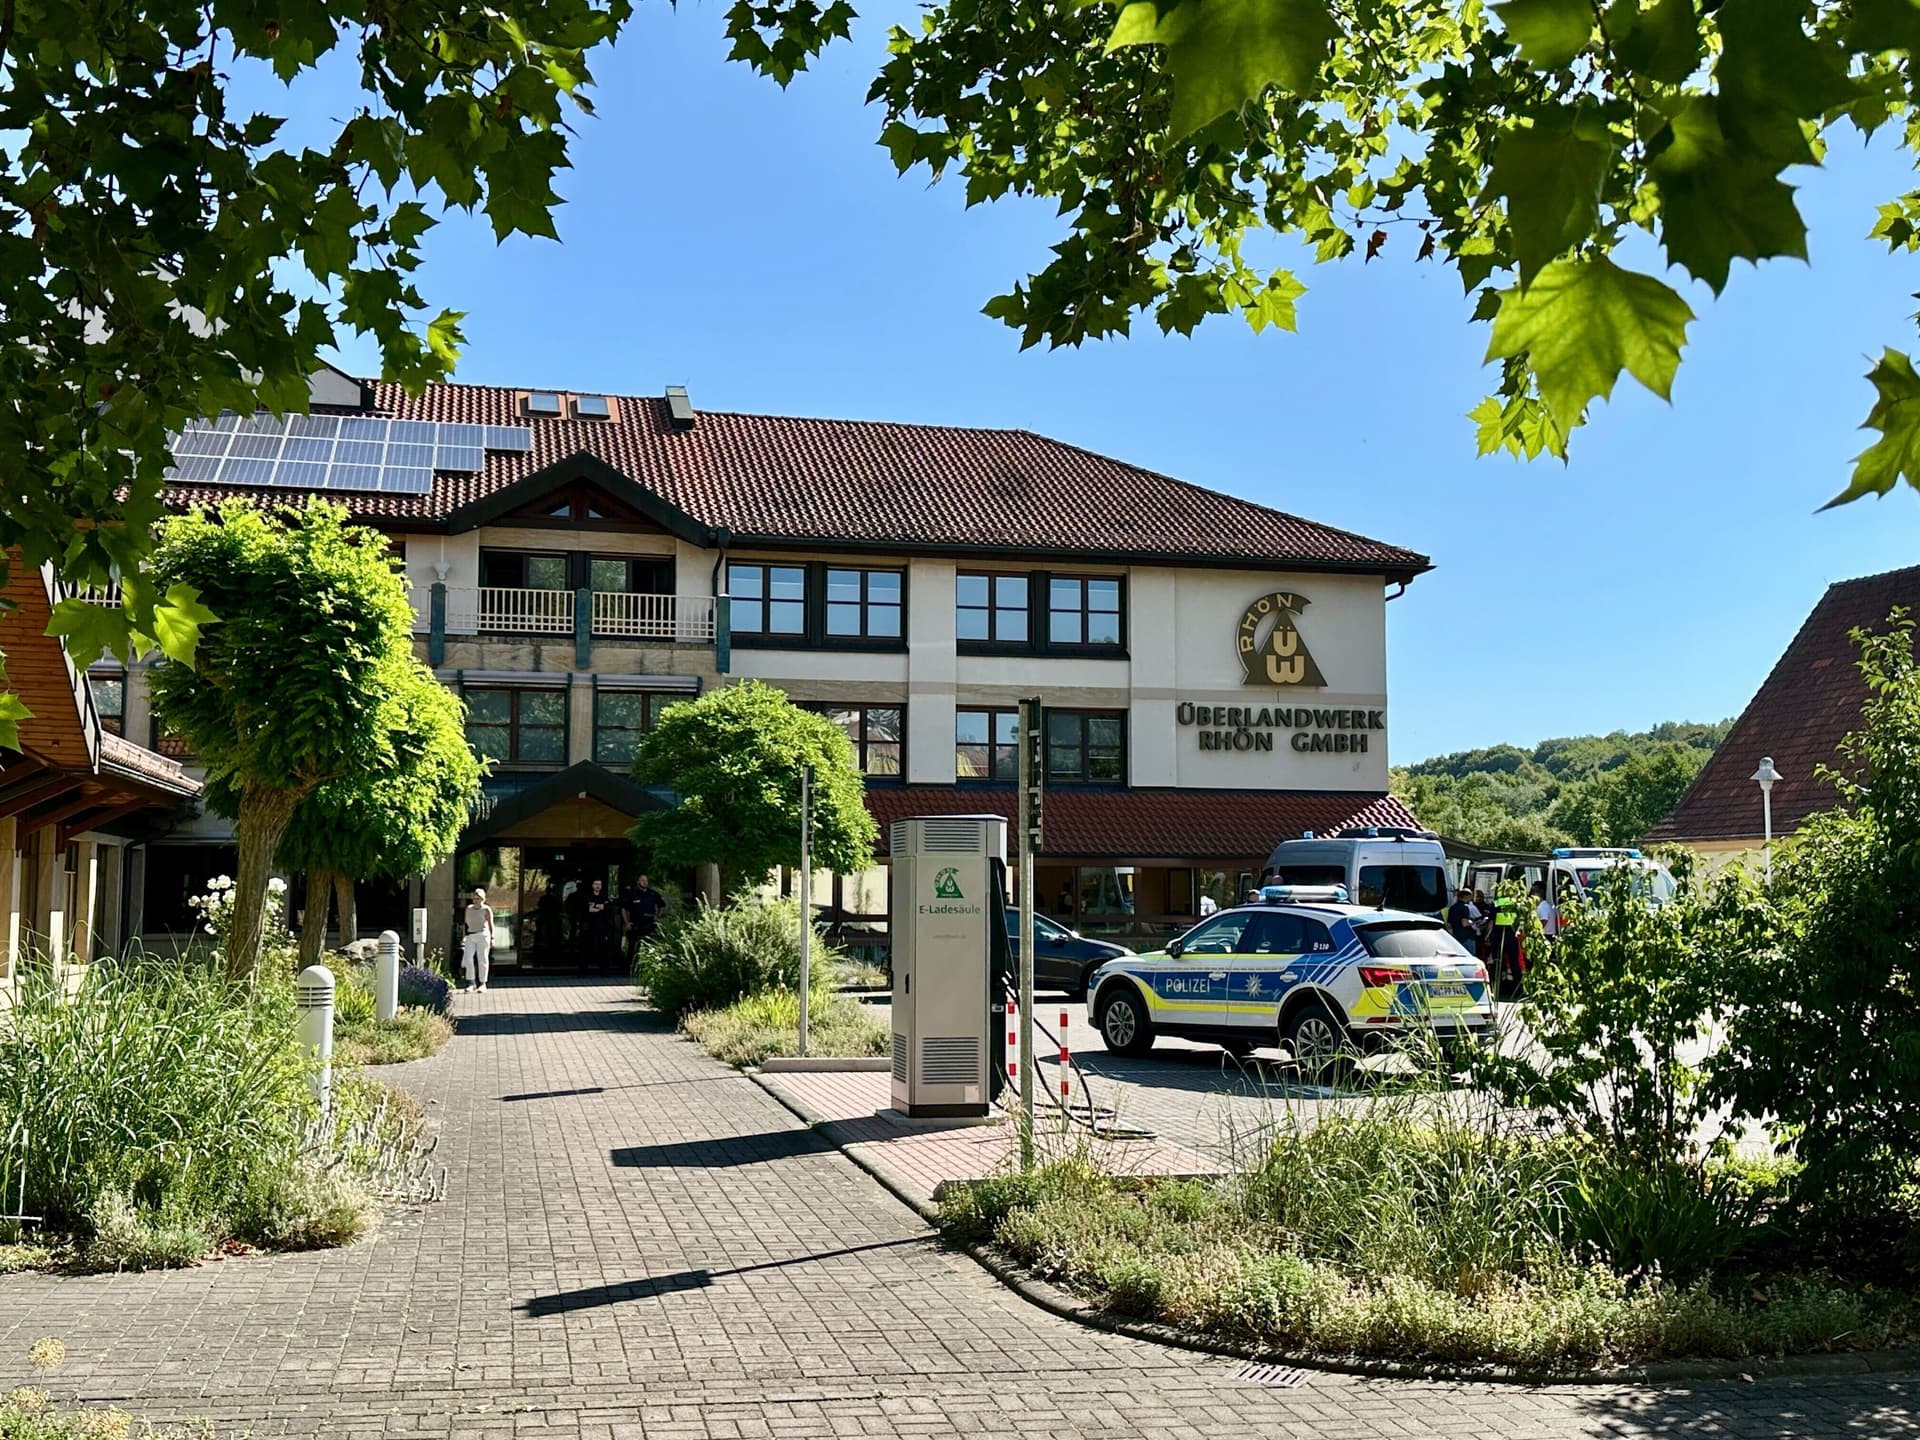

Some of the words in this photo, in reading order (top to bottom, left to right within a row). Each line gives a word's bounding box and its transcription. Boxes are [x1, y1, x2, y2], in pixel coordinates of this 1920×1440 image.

[1240, 593, 1293, 653] RHÖN
[1177, 702, 1385, 729] ÜBERLANDWERK
[1199, 727, 1273, 751] RHÖN
[1290, 732, 1368, 753] GMBH
[919, 904, 981, 914] E-Ladesäule
[1165, 978, 1210, 993] POLIZEI
